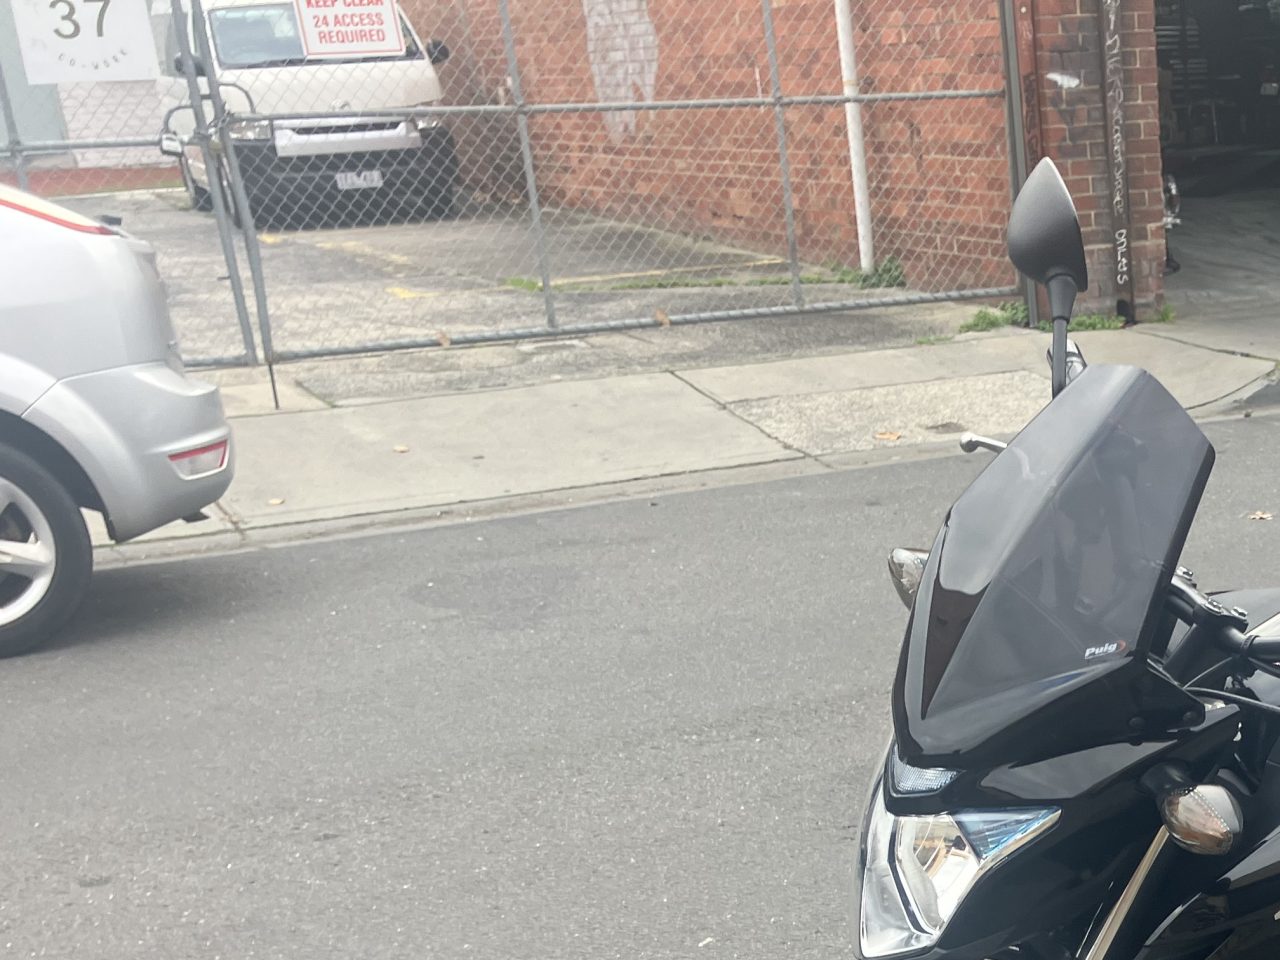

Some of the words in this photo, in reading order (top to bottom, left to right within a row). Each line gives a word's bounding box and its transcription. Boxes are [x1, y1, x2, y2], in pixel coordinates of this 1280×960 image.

[49, 0, 111, 39] 37
[313, 14, 329, 28] 24
[334, 12, 384, 27] ACCESS
[318, 29, 385, 44] REQUIRED
